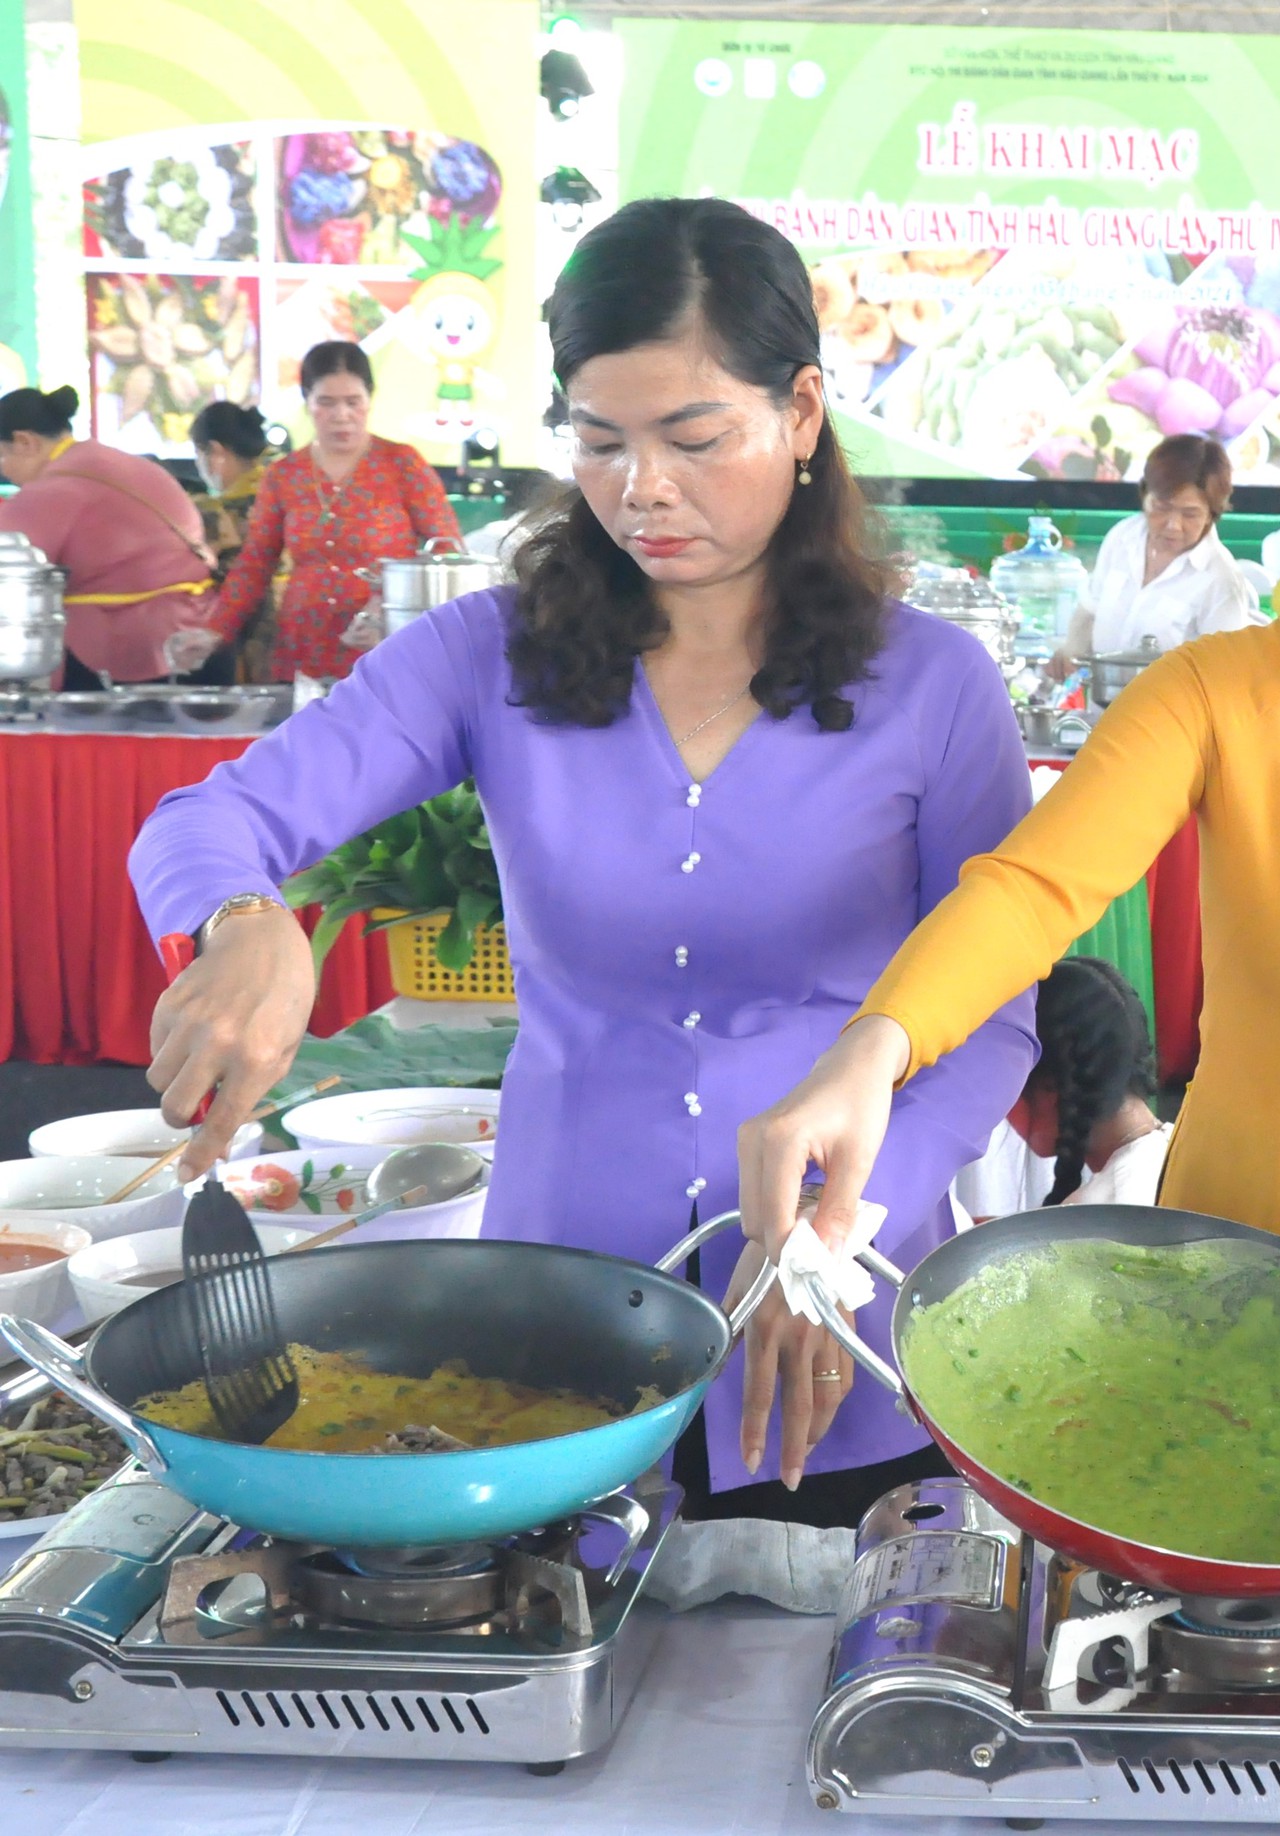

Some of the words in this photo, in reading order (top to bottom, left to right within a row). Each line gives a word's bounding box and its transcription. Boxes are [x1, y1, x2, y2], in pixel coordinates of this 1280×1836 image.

[990, 131, 1088, 168] KHAI
[1106, 134, 1193, 181] MẠC
[903, 208, 957, 242] GIAN
[1084, 213, 1155, 248] GIANG
